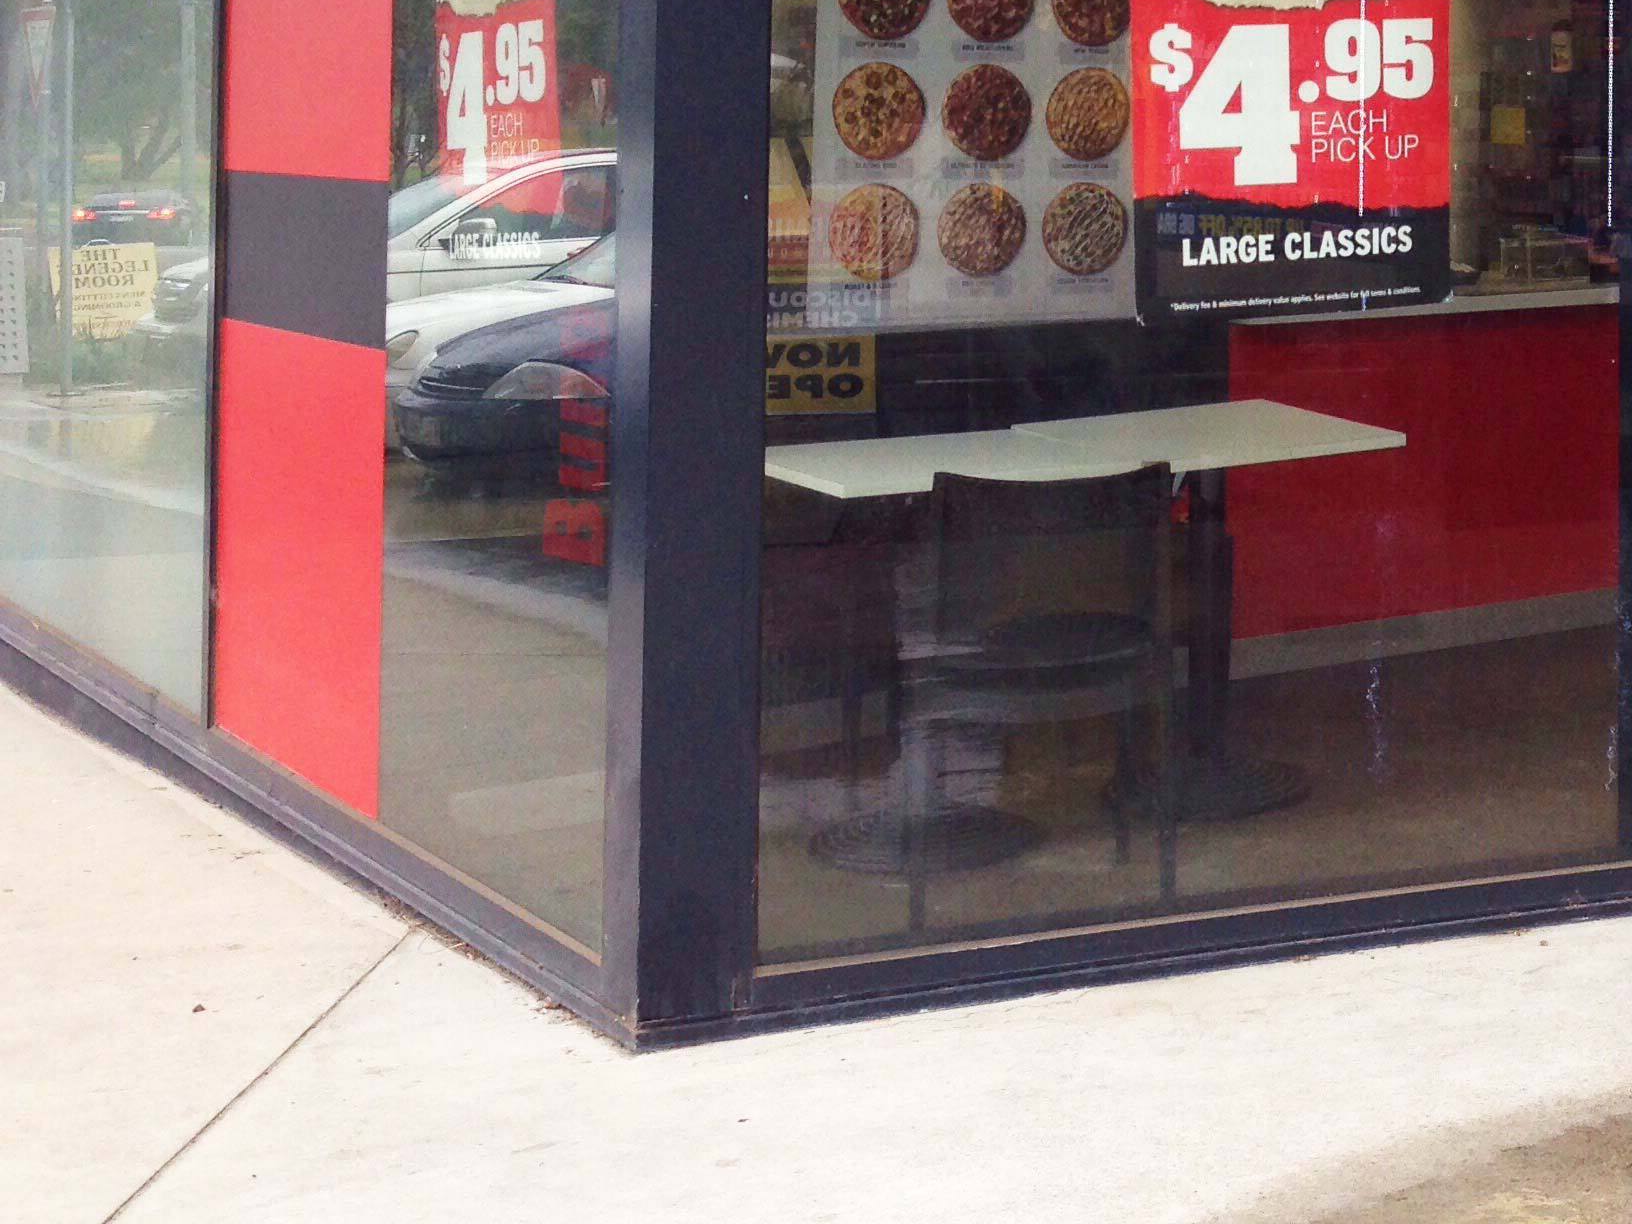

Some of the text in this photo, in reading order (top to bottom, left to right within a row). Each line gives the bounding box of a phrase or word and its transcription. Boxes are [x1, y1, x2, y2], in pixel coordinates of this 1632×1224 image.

[438, 19, 546, 186] $4.95
[1149, 18, 1435, 187] $4.95
[490, 112, 523, 137] EACH
[1311, 109, 1388, 135] EACH
[490, 137, 540, 162] PICK UP
[1311, 134, 1420, 164] PICK UP
[449, 231, 541, 262] LARGE CLASSICS
[1182, 234, 1275, 267] LARGE
[1284, 225, 1413, 260] CLASSICS
[1200, 301, 1211, 309] fee
[1218, 299, 1247, 308] minimum
[1248, 297, 1272, 307] delivery
[1273, 296, 1290, 305] value
[1314, 293, 1325, 301] See
[1326, 292, 1349, 300] website
[1350, 291, 1359, 299] for
